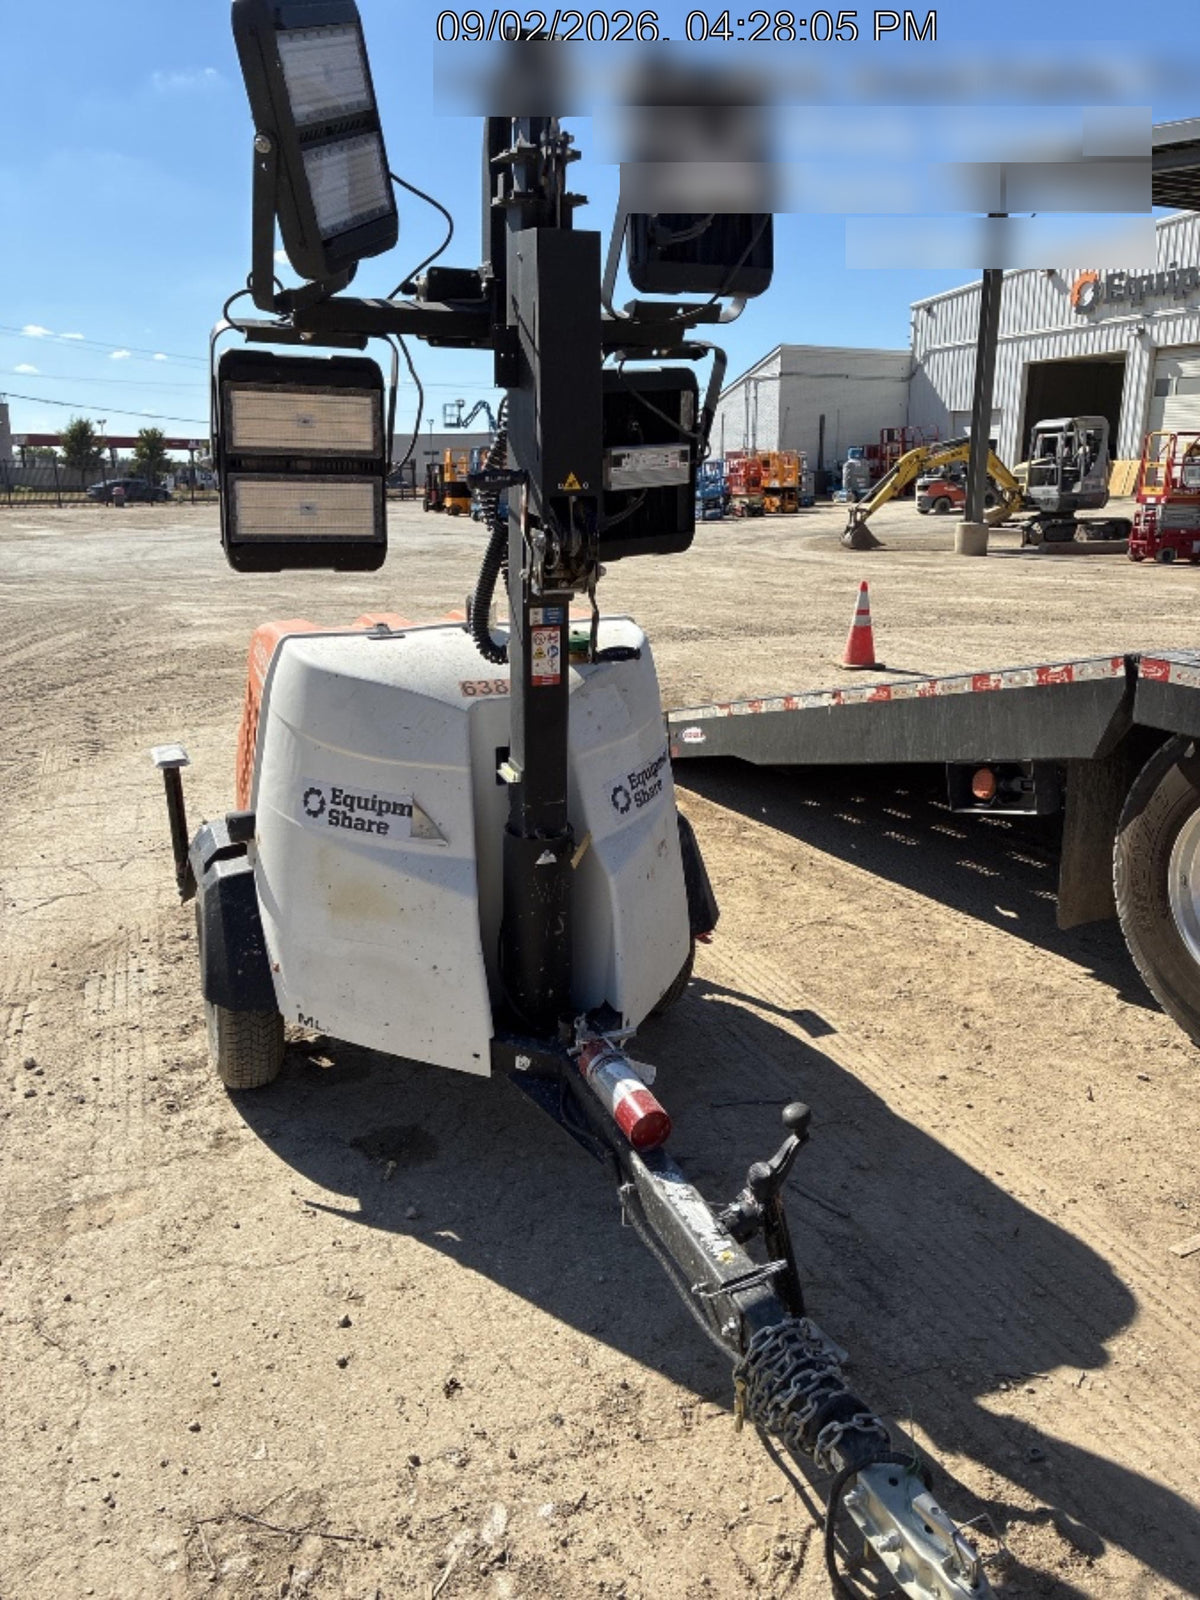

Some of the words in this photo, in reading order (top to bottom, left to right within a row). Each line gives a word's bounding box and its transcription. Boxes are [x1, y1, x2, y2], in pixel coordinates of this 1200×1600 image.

[461, 678, 509, 696] 638
[330, 787, 413, 817] Equipm
[328, 808, 390, 836] Share
